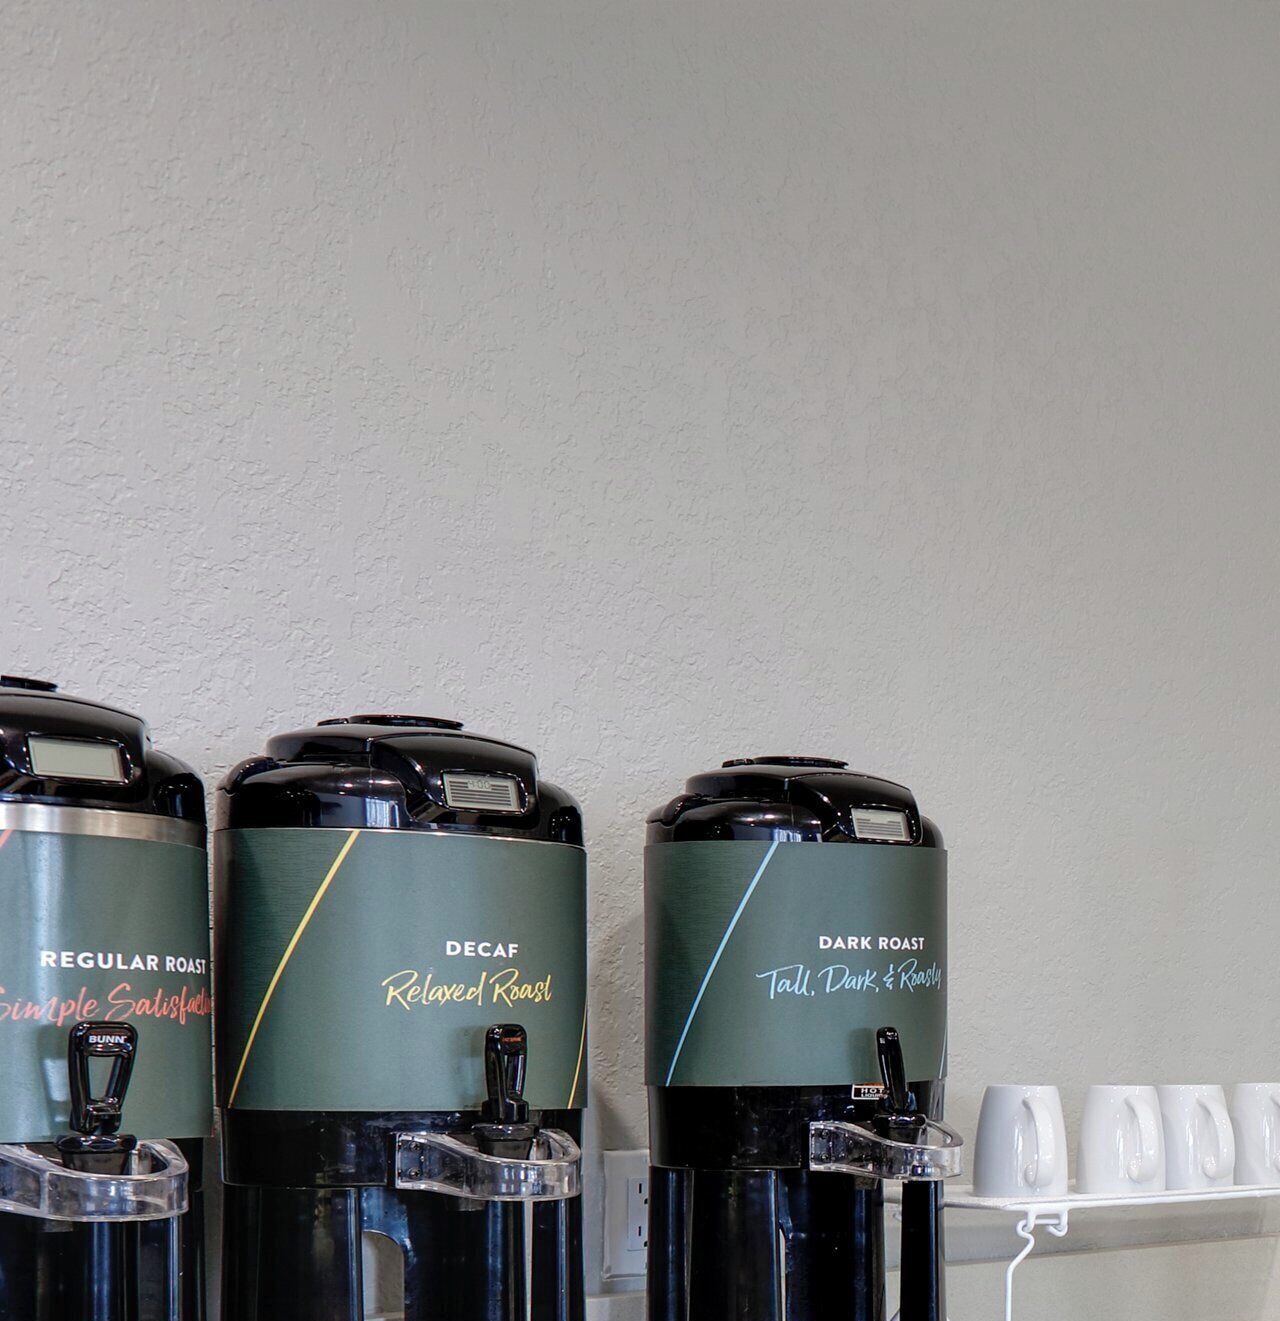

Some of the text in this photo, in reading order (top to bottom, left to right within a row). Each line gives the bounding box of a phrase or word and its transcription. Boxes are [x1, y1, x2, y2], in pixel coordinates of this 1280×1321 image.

[446, 941, 518, 958] DECAF
[819, 936, 925, 951] DARK ROAST
[40, 951, 206, 974] REGULAR ROAST
[756, 964, 815, 999] Tall,
[818, 964, 879, 993] Dark,
[897, 958, 942, 992] Roasty
[381, 968, 552, 1010] Relaxed Roast
[88, 1035, 125, 1044] BUNN
